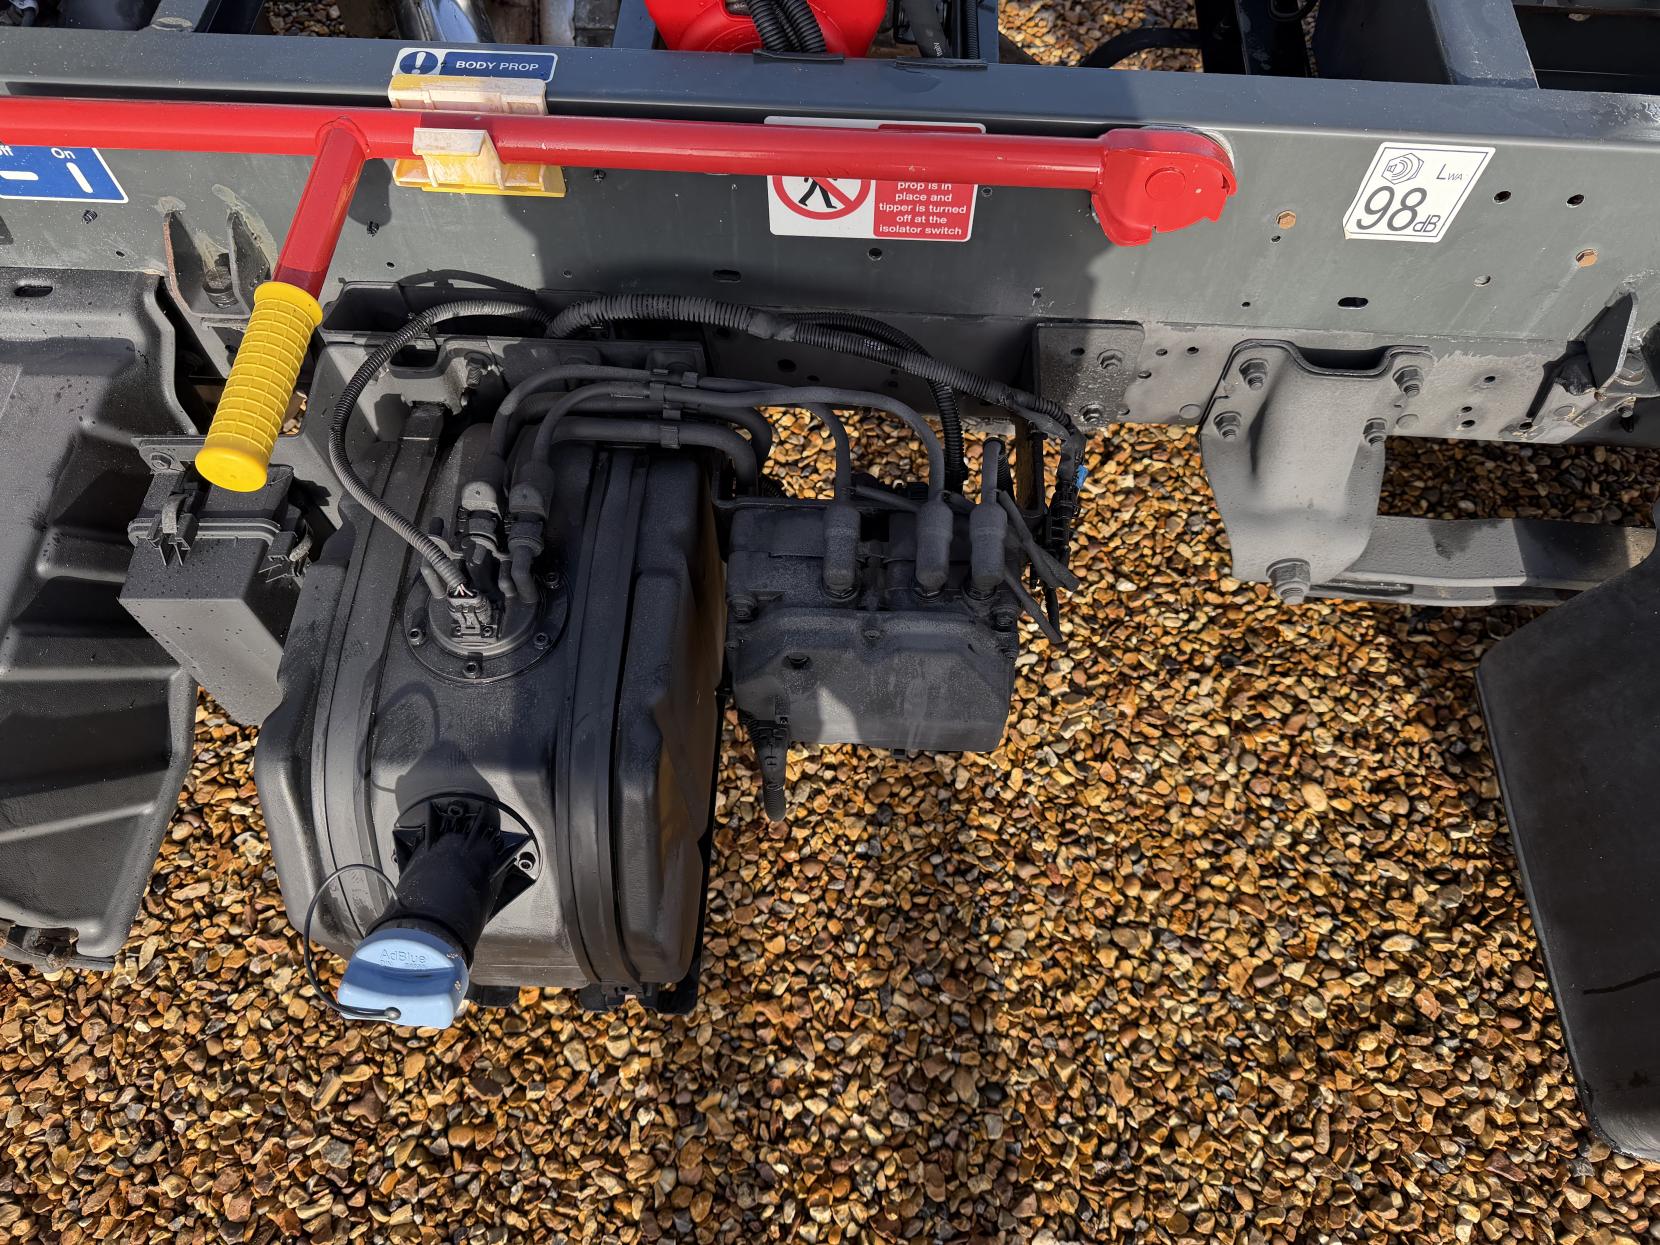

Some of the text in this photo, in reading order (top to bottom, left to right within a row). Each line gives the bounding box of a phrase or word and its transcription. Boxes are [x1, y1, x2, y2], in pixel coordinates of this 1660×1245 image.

[456, 60, 539, 71] BODY PROP
[0, 144, 14, 156] ff
[50, 147, 76, 159] On
[897, 182, 925, 190] prop
[896, 192, 952, 202] place and
[879, 202, 967, 214] tipper is turned
[1356, 185, 1441, 233] 98 dB
[896, 214, 948, 224] off at the
[879, 224, 962, 235] isolator switch
[380, 948, 426, 964] AdBlue
